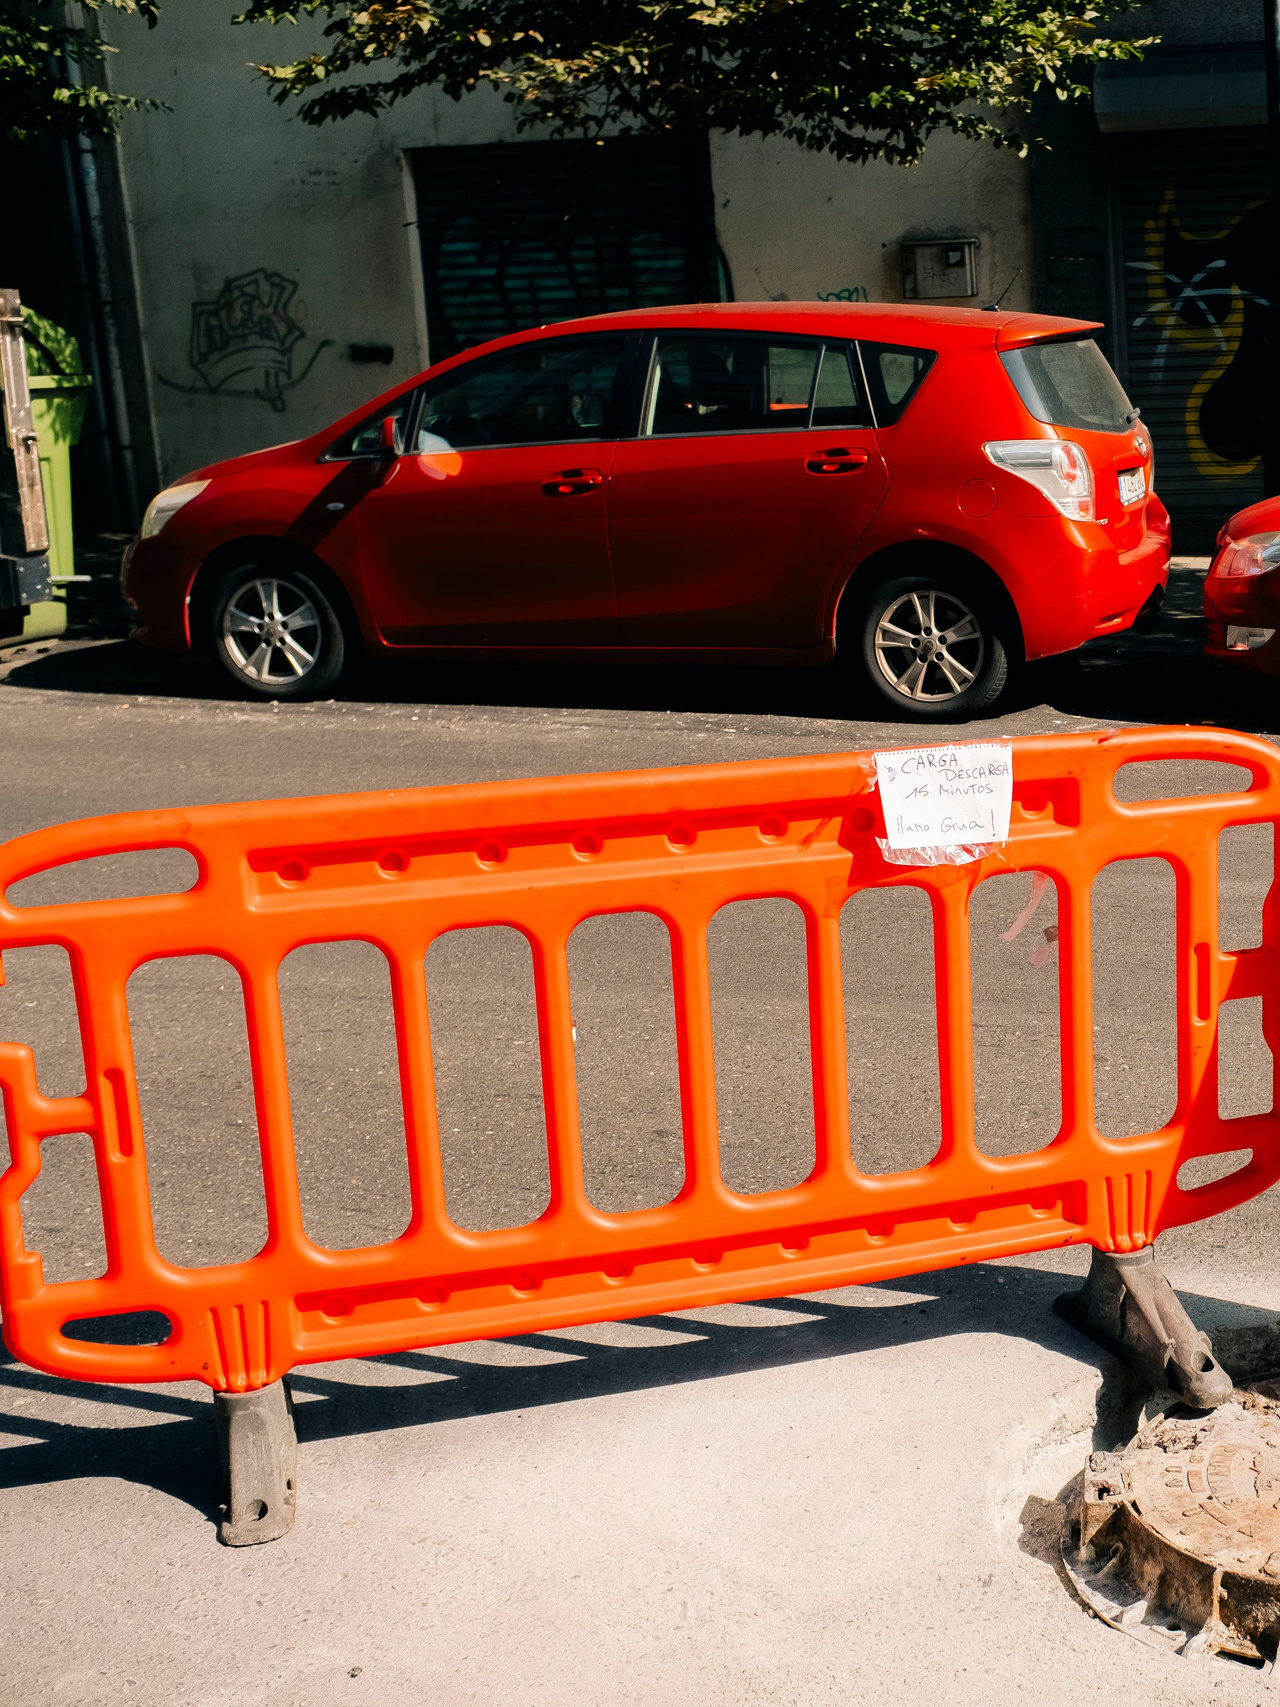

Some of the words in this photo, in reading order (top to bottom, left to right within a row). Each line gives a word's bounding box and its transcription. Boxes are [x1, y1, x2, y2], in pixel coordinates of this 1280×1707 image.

[901, 753, 959, 774] CARGA
[938, 762, 1010, 782] DESCARGA
[905, 784, 929, 799] 15
